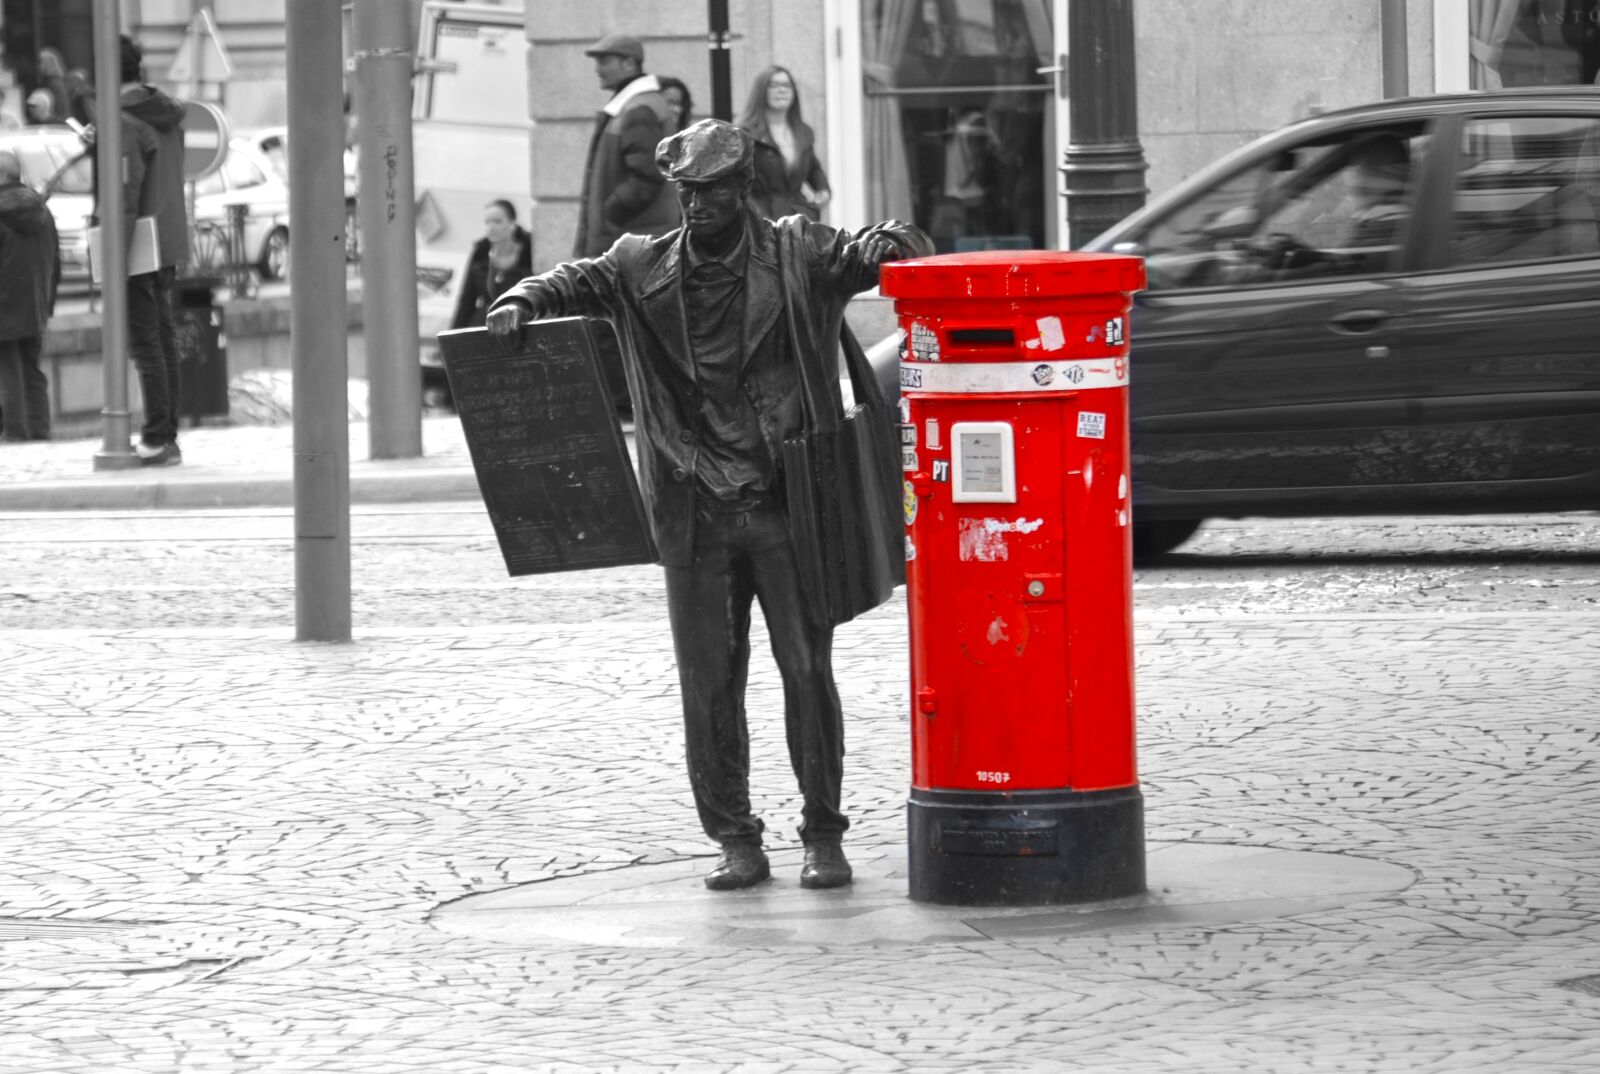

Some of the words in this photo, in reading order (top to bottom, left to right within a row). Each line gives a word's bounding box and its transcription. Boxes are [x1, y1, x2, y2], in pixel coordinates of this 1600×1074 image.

[1079, 414, 1104, 424] BEAT
[932, 460, 949, 482] PT
[976, 771, 1011, 783] 10507
